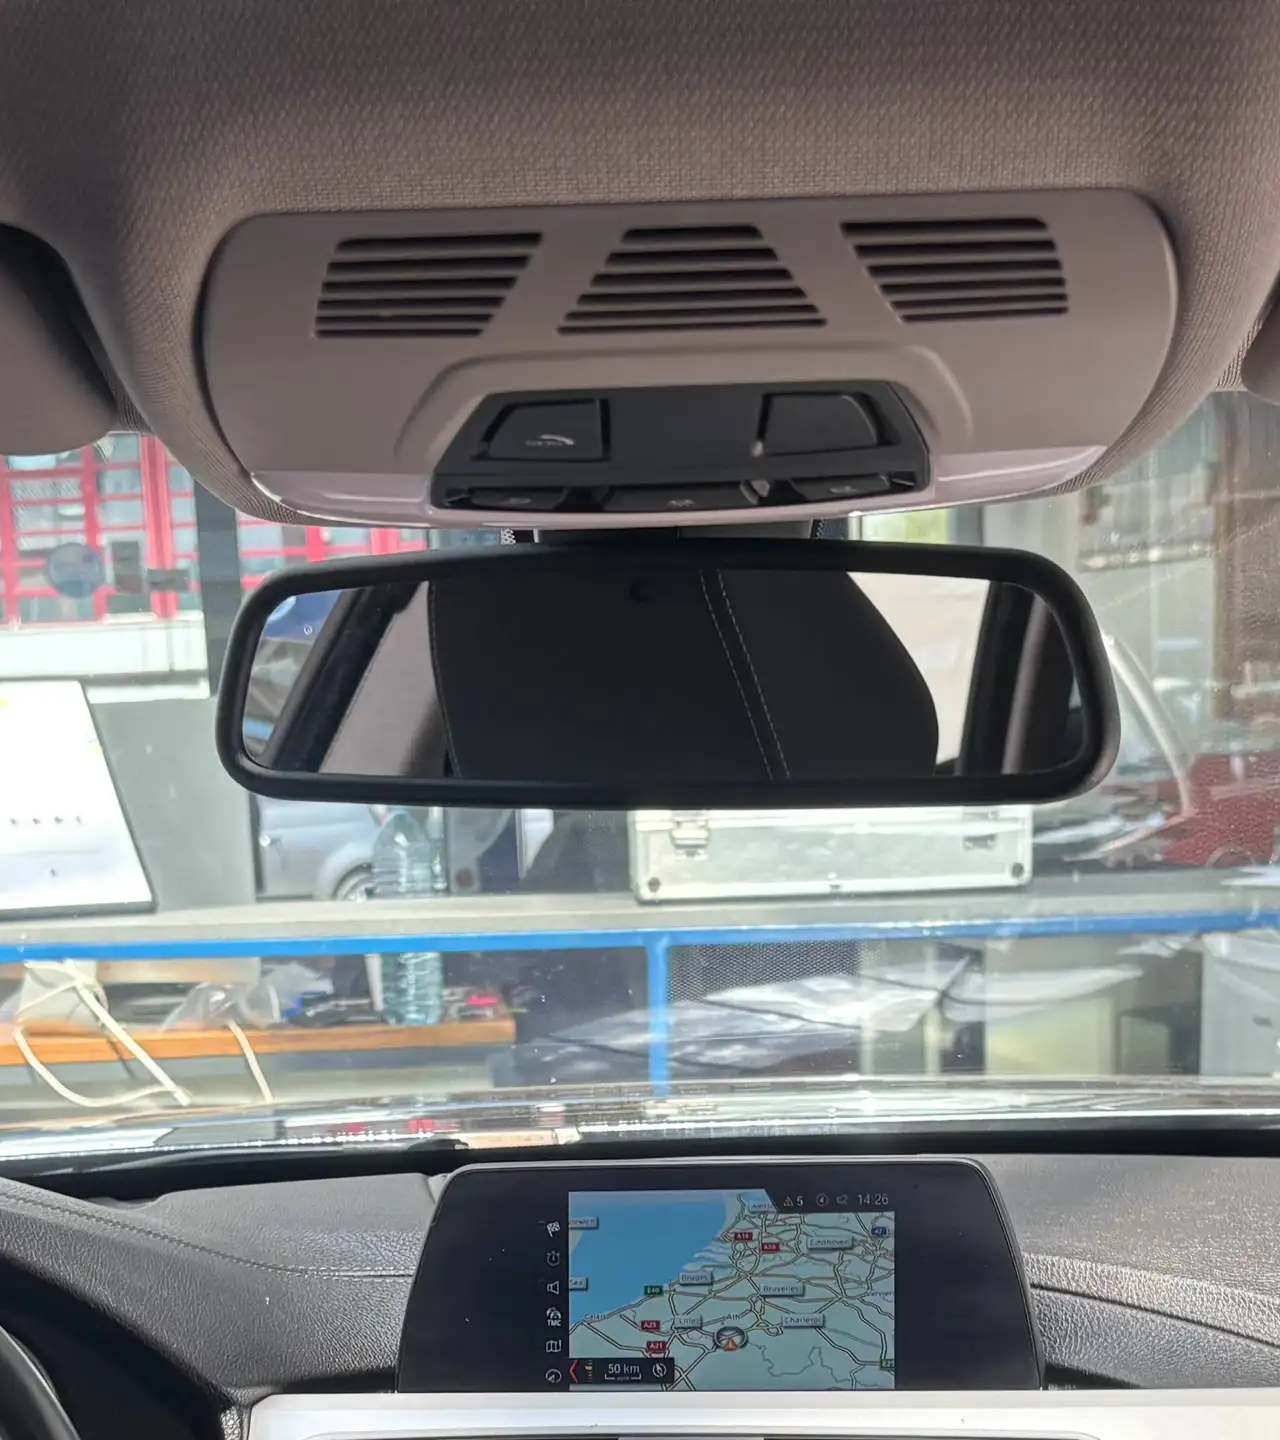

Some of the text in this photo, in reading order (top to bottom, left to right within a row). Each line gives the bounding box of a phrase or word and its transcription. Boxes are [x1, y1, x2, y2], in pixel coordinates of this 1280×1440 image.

[796, 1194, 889, 1207] 5 14:26
[681, 1274, 709, 1284] Bruges
[763, 1284, 799, 1293] Bruxelles
[784, 1316, 819, 1324] Charleroi
[608, 1363, 640, 1374] 50 km
